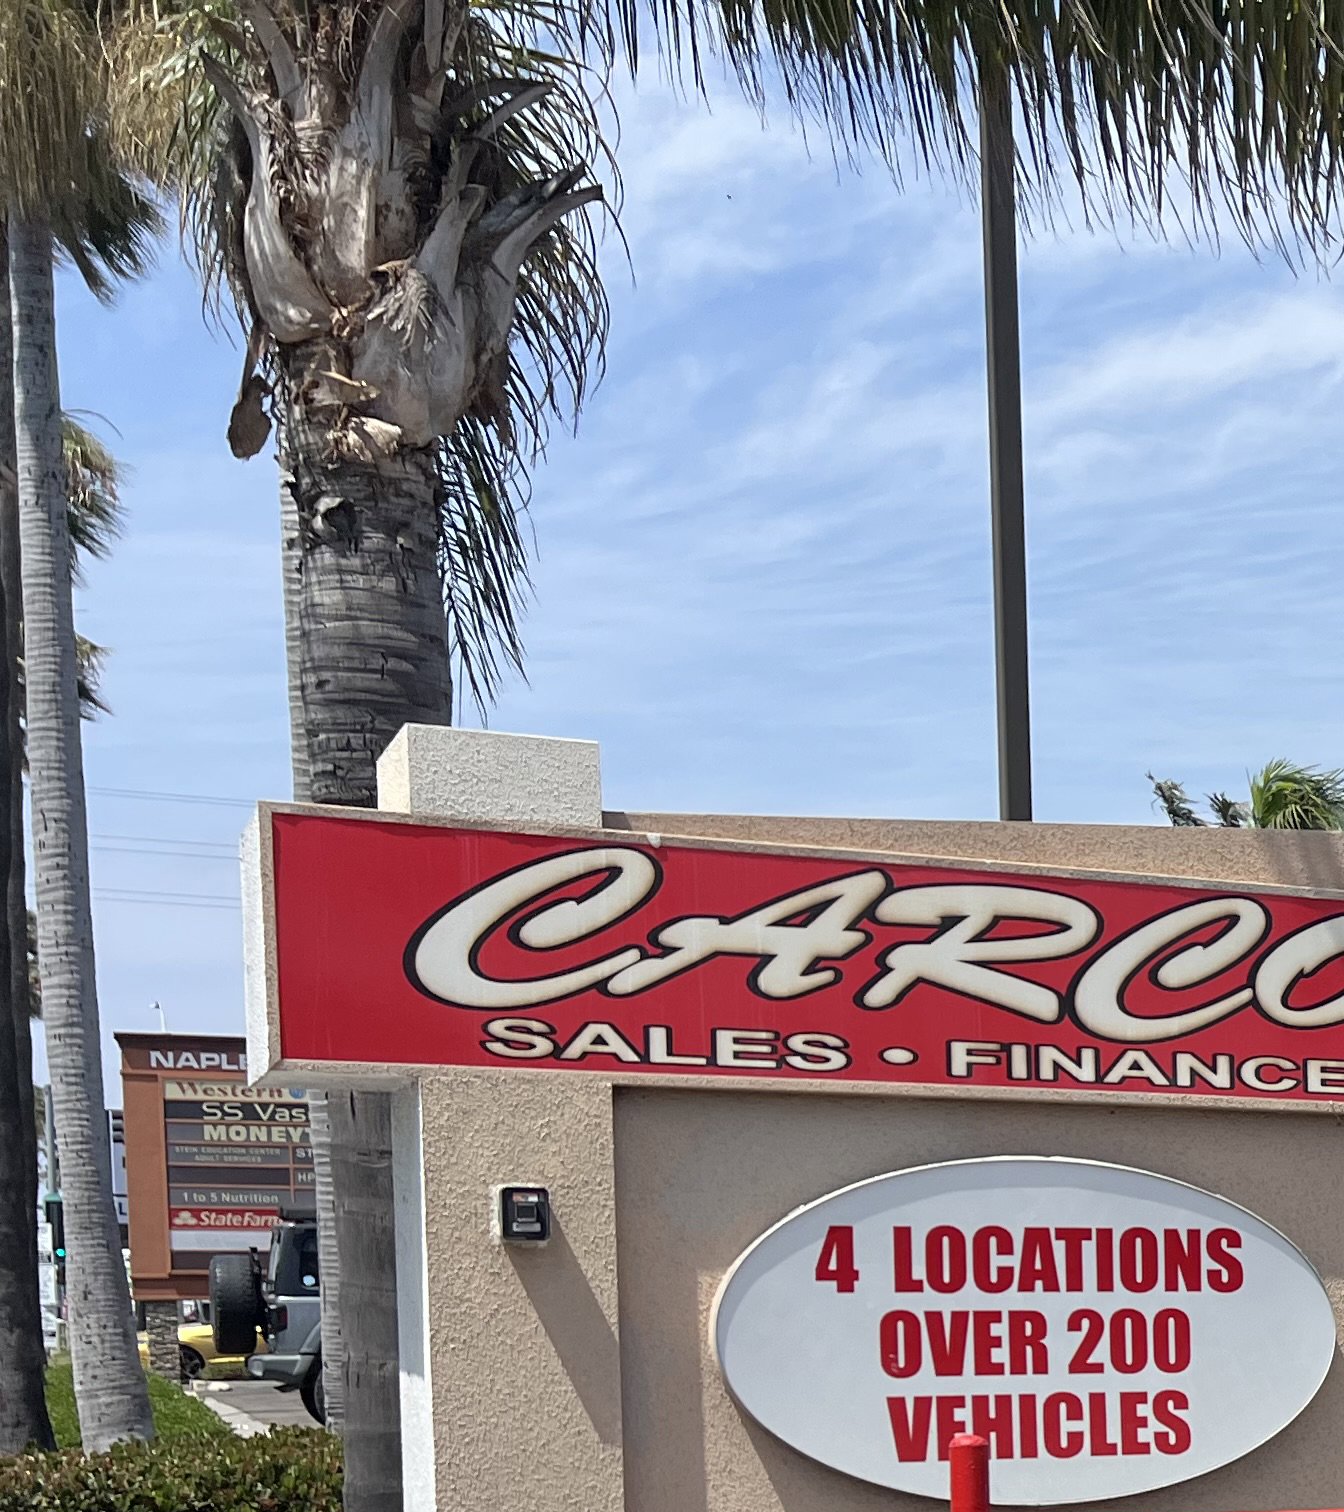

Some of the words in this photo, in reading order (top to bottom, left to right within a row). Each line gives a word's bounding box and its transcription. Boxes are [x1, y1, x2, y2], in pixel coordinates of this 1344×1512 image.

[480, 1016, 852, 1072] SALES
[175, 1081, 284, 1099] Western
[202, 1102, 244, 1121] SS
[183, 1192, 189, 1201] 1
[193, 1192, 206, 1202] to
[210, 1192, 218, 1203] 5
[221, 1193, 279, 1204] Nutrition
[815, 1225, 860, 1294] 4
[892, 1225, 1245, 1294] LOCATIONS
[879, 1308, 1049, 1379] OVER
[1067, 1307, 1192, 1375] 200
[885, 1389, 1192, 1463] VEHICLES
